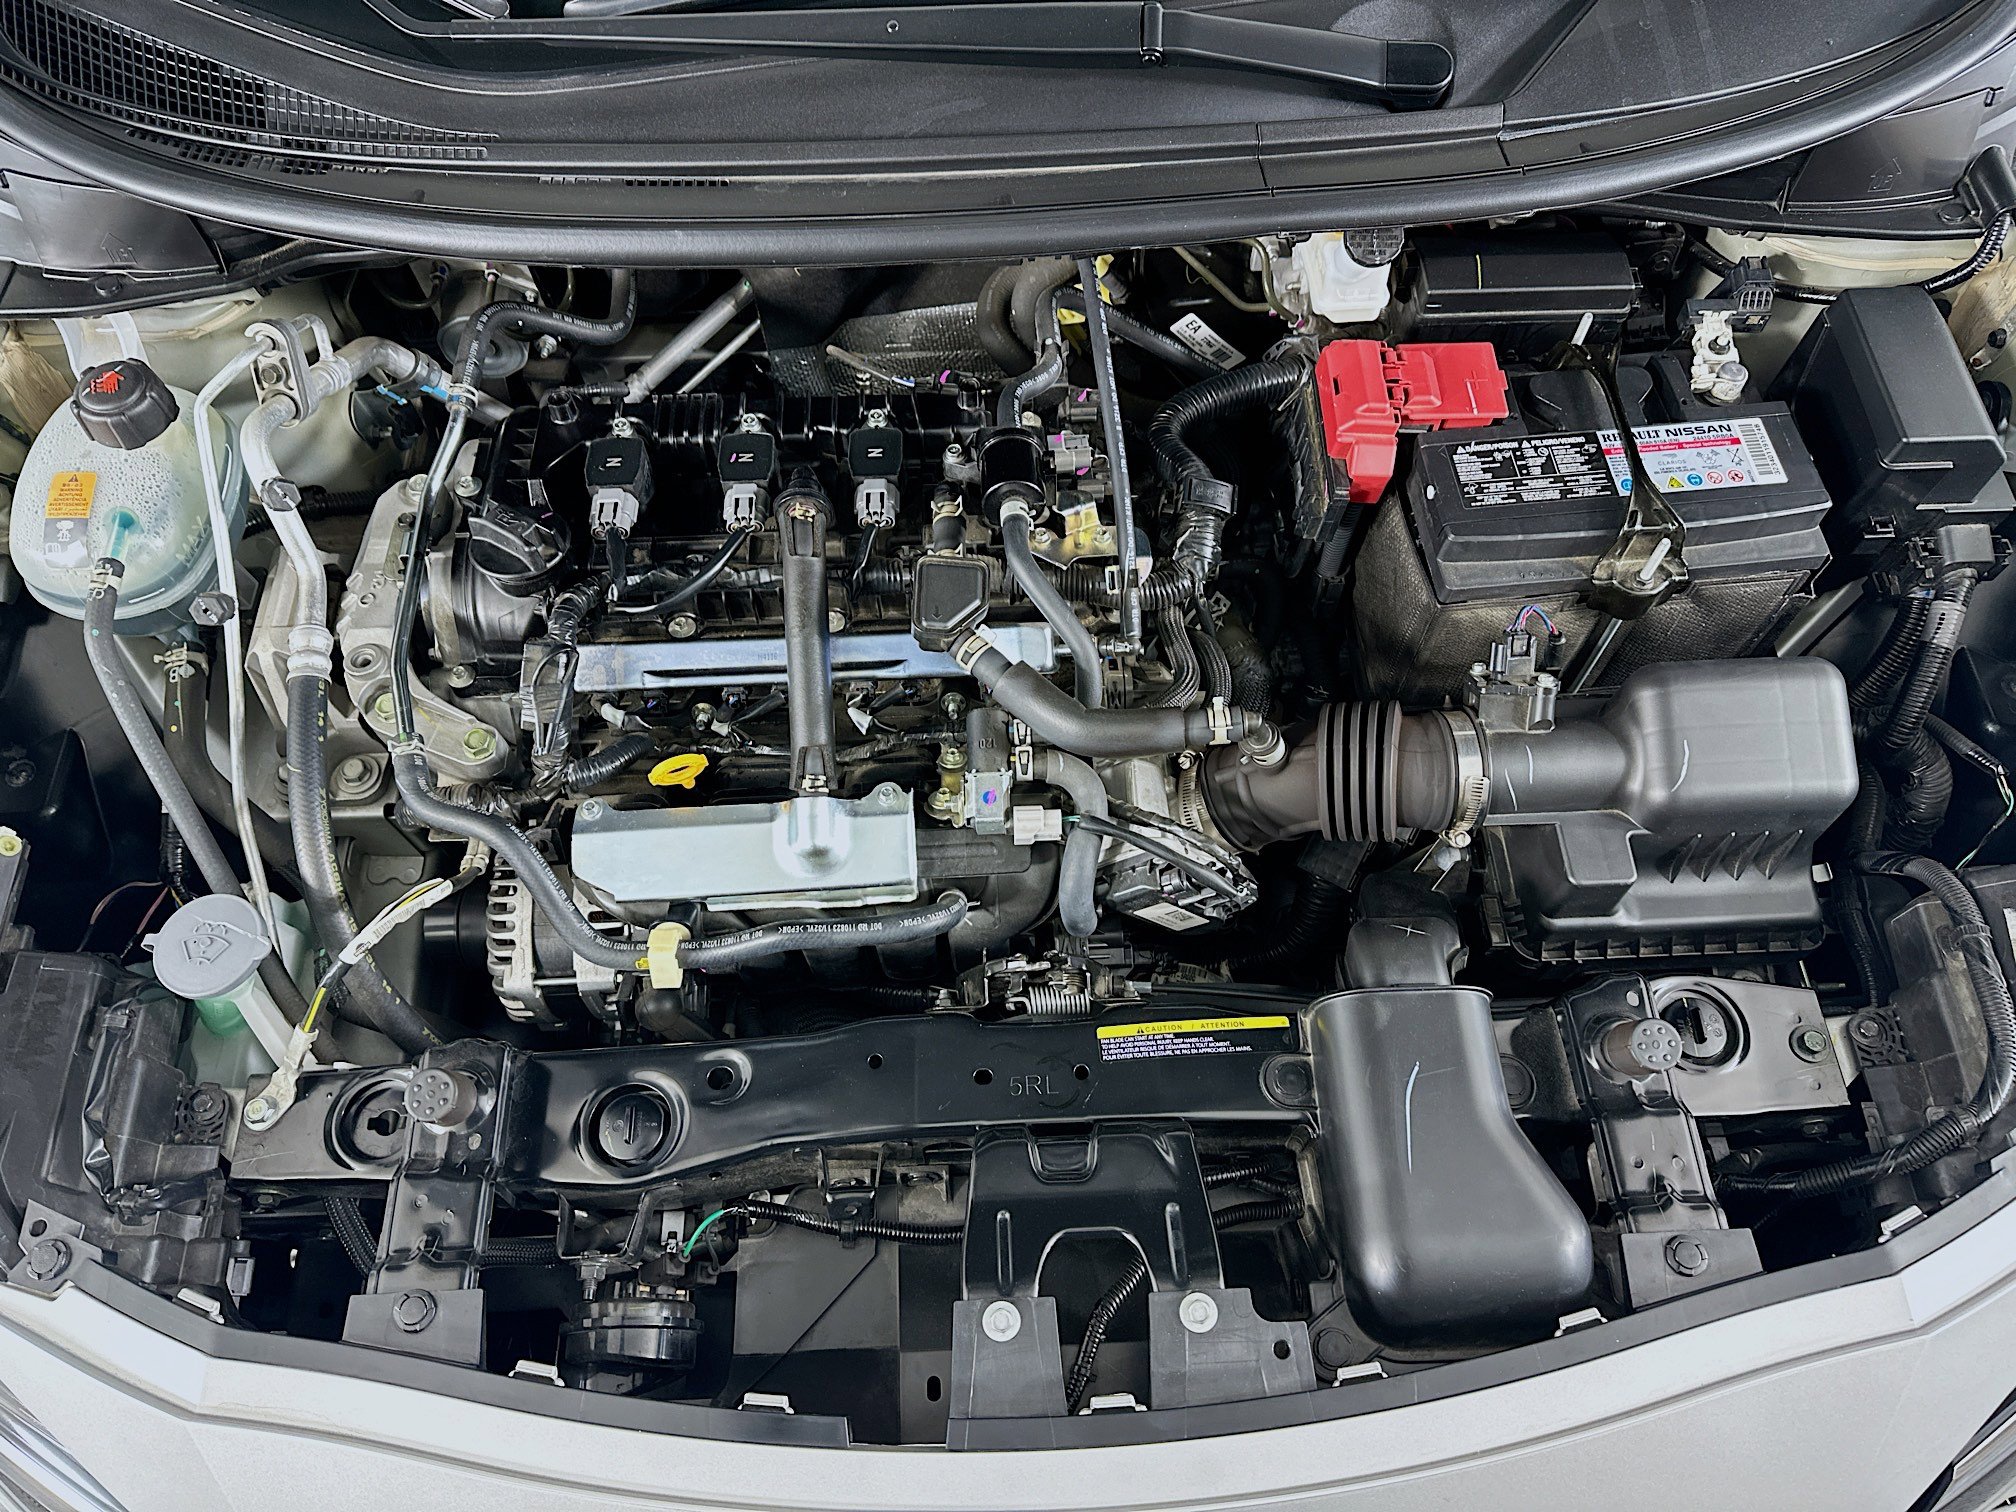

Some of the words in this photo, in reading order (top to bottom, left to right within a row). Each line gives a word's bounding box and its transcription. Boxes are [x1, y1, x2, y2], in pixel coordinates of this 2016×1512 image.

[1186, 320, 1201, 334] EA
[1601, 429, 1660, 442] REAULT
[1665, 424, 1732, 437] NISSAN
[320, 799, 332, 846] YOKOHAMA
[833, 923, 856, 932] 110823
[870, 922, 883, 931] DOT
[752, 929, 763, 939] DOT
[1146, 1024, 1183, 1032] CAUTION
[1201, 1021, 1245, 1029] ATTENTION
[1009, 1074, 1059, 1097] 5RL
